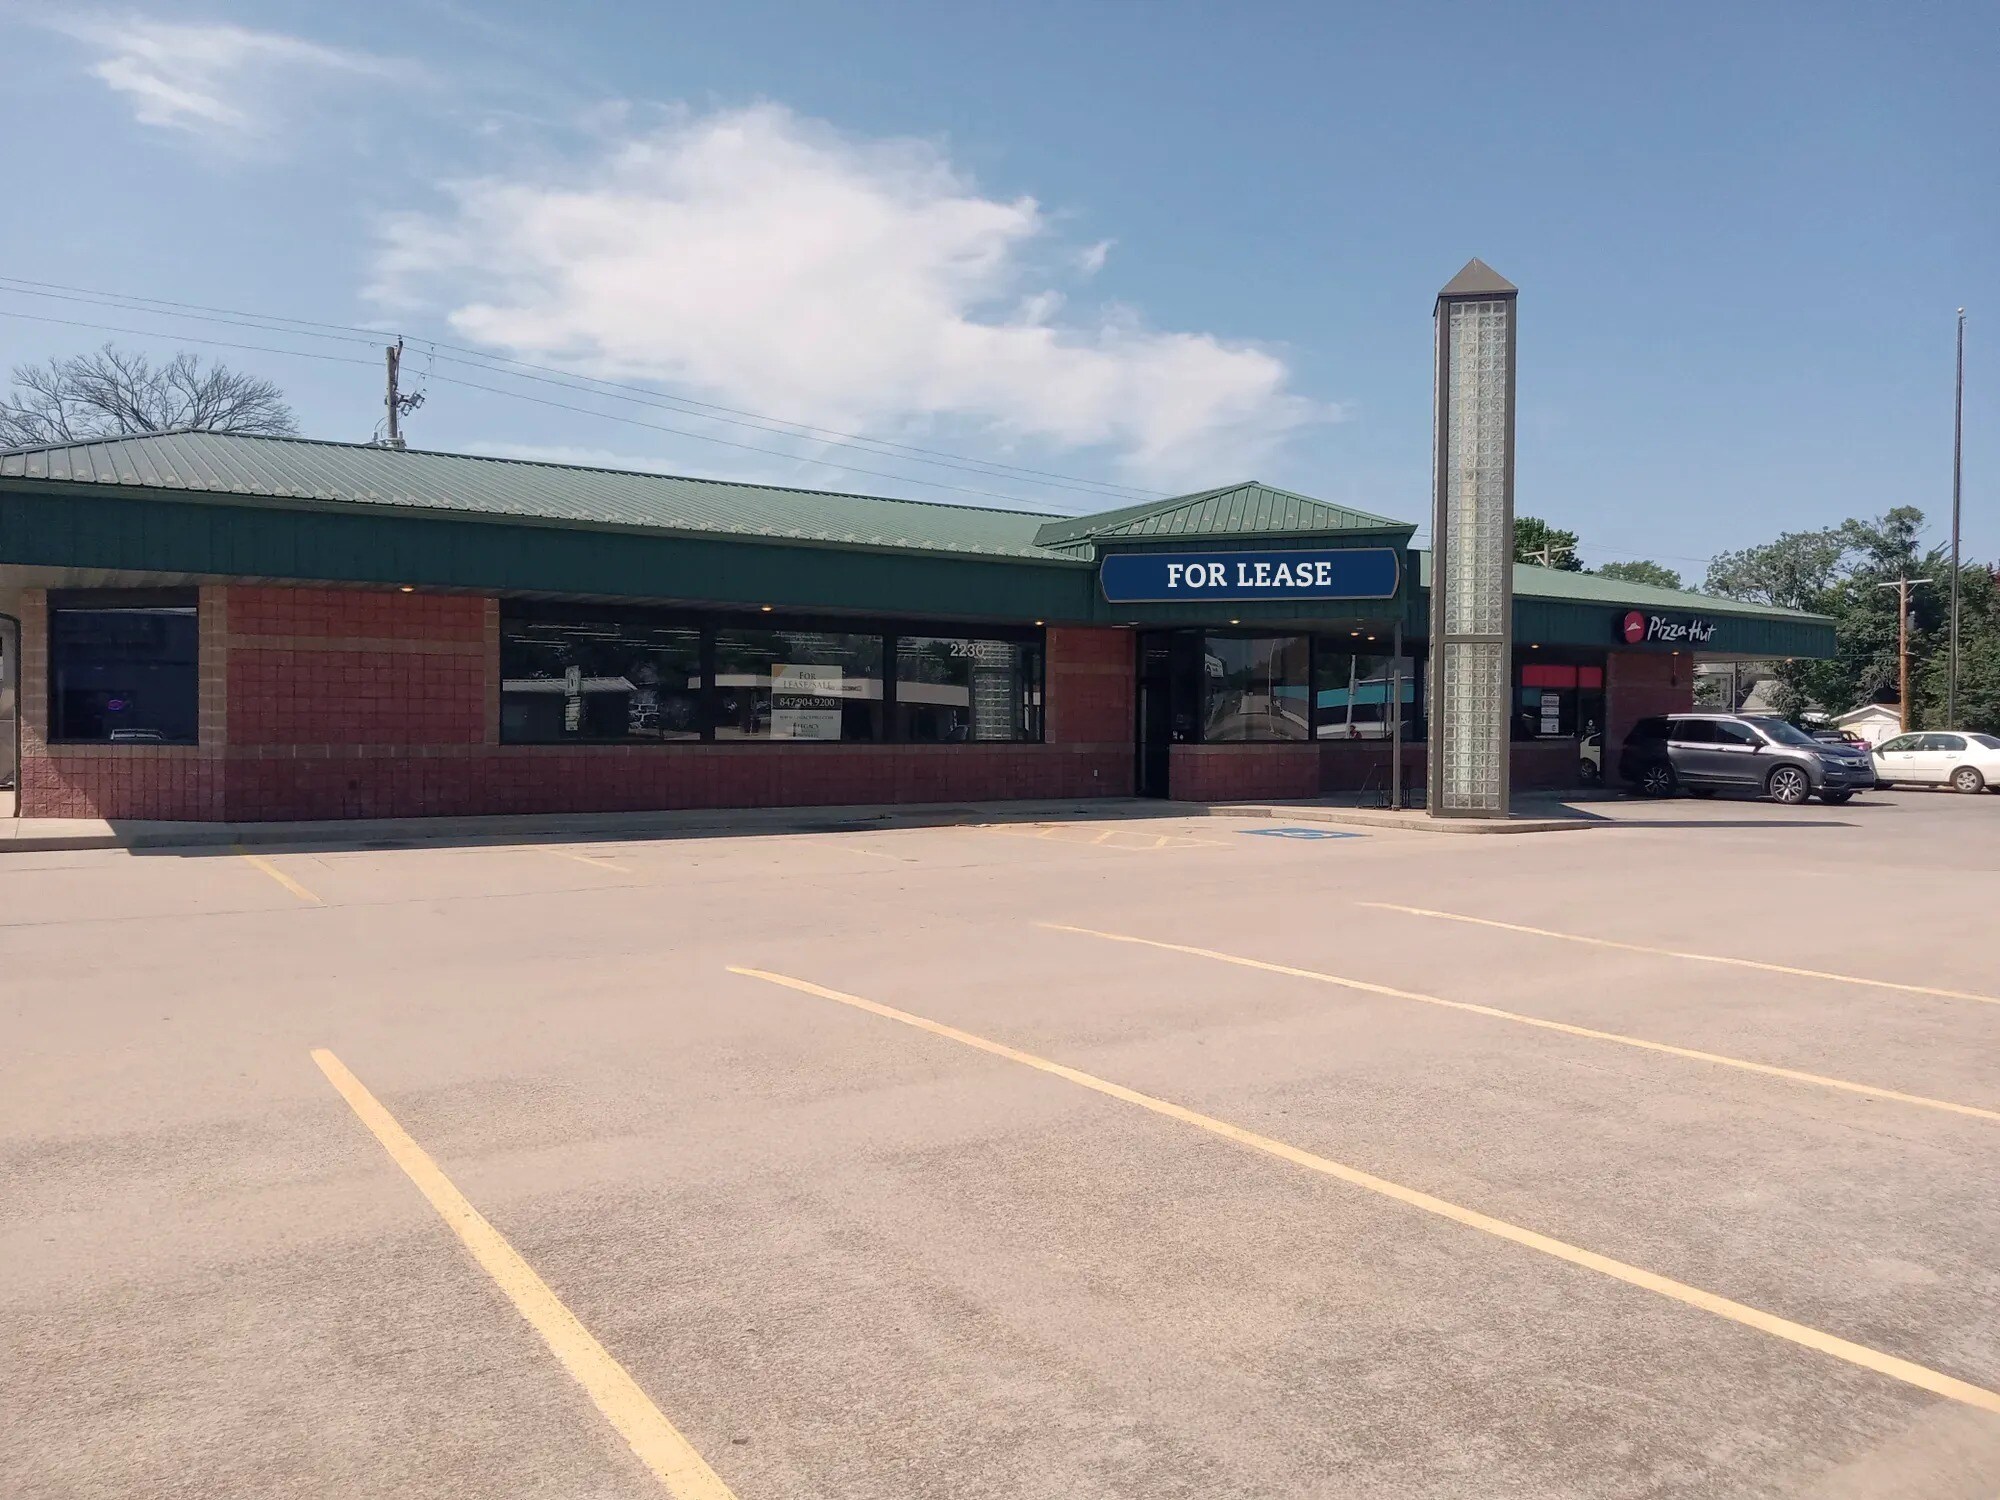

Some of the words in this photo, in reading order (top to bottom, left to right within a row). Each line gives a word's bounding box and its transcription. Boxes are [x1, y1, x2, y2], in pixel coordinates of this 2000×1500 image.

[1167, 563, 1227, 588] FOR
[1237, 562, 1331, 587] LEASE
[1647, 616, 1687, 641] Pizza
[1688, 620, 1717, 642] Hut
[950, 643, 985, 657] 2230
[799, 671, 816, 680] FOR
